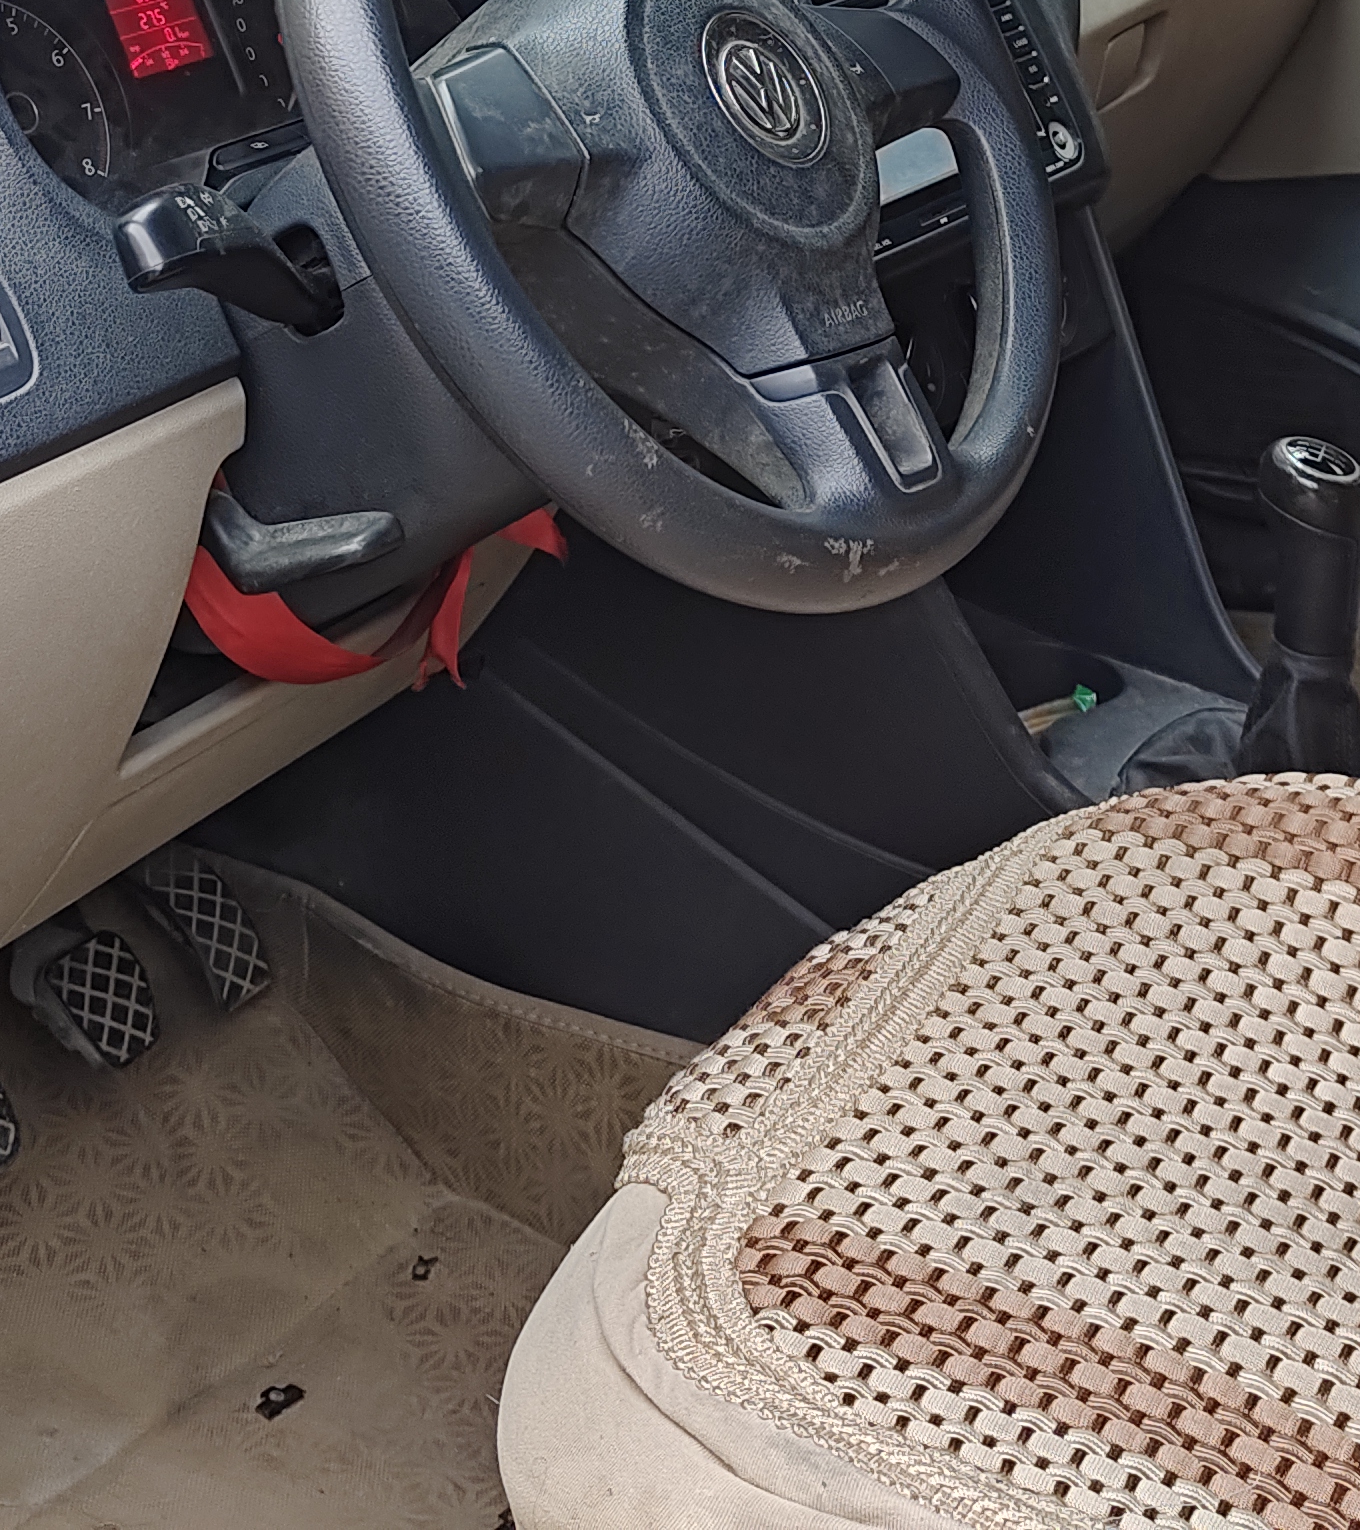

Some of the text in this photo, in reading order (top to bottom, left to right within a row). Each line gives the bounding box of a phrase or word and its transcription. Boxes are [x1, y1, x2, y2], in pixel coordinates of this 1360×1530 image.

[5, 18, 19, 36] 5
[51, 49, 65, 68] 6
[80, 102, 93, 121] 7
[81, 158, 96, 177] 8
[823, 299, 869, 328] AIRBAG
